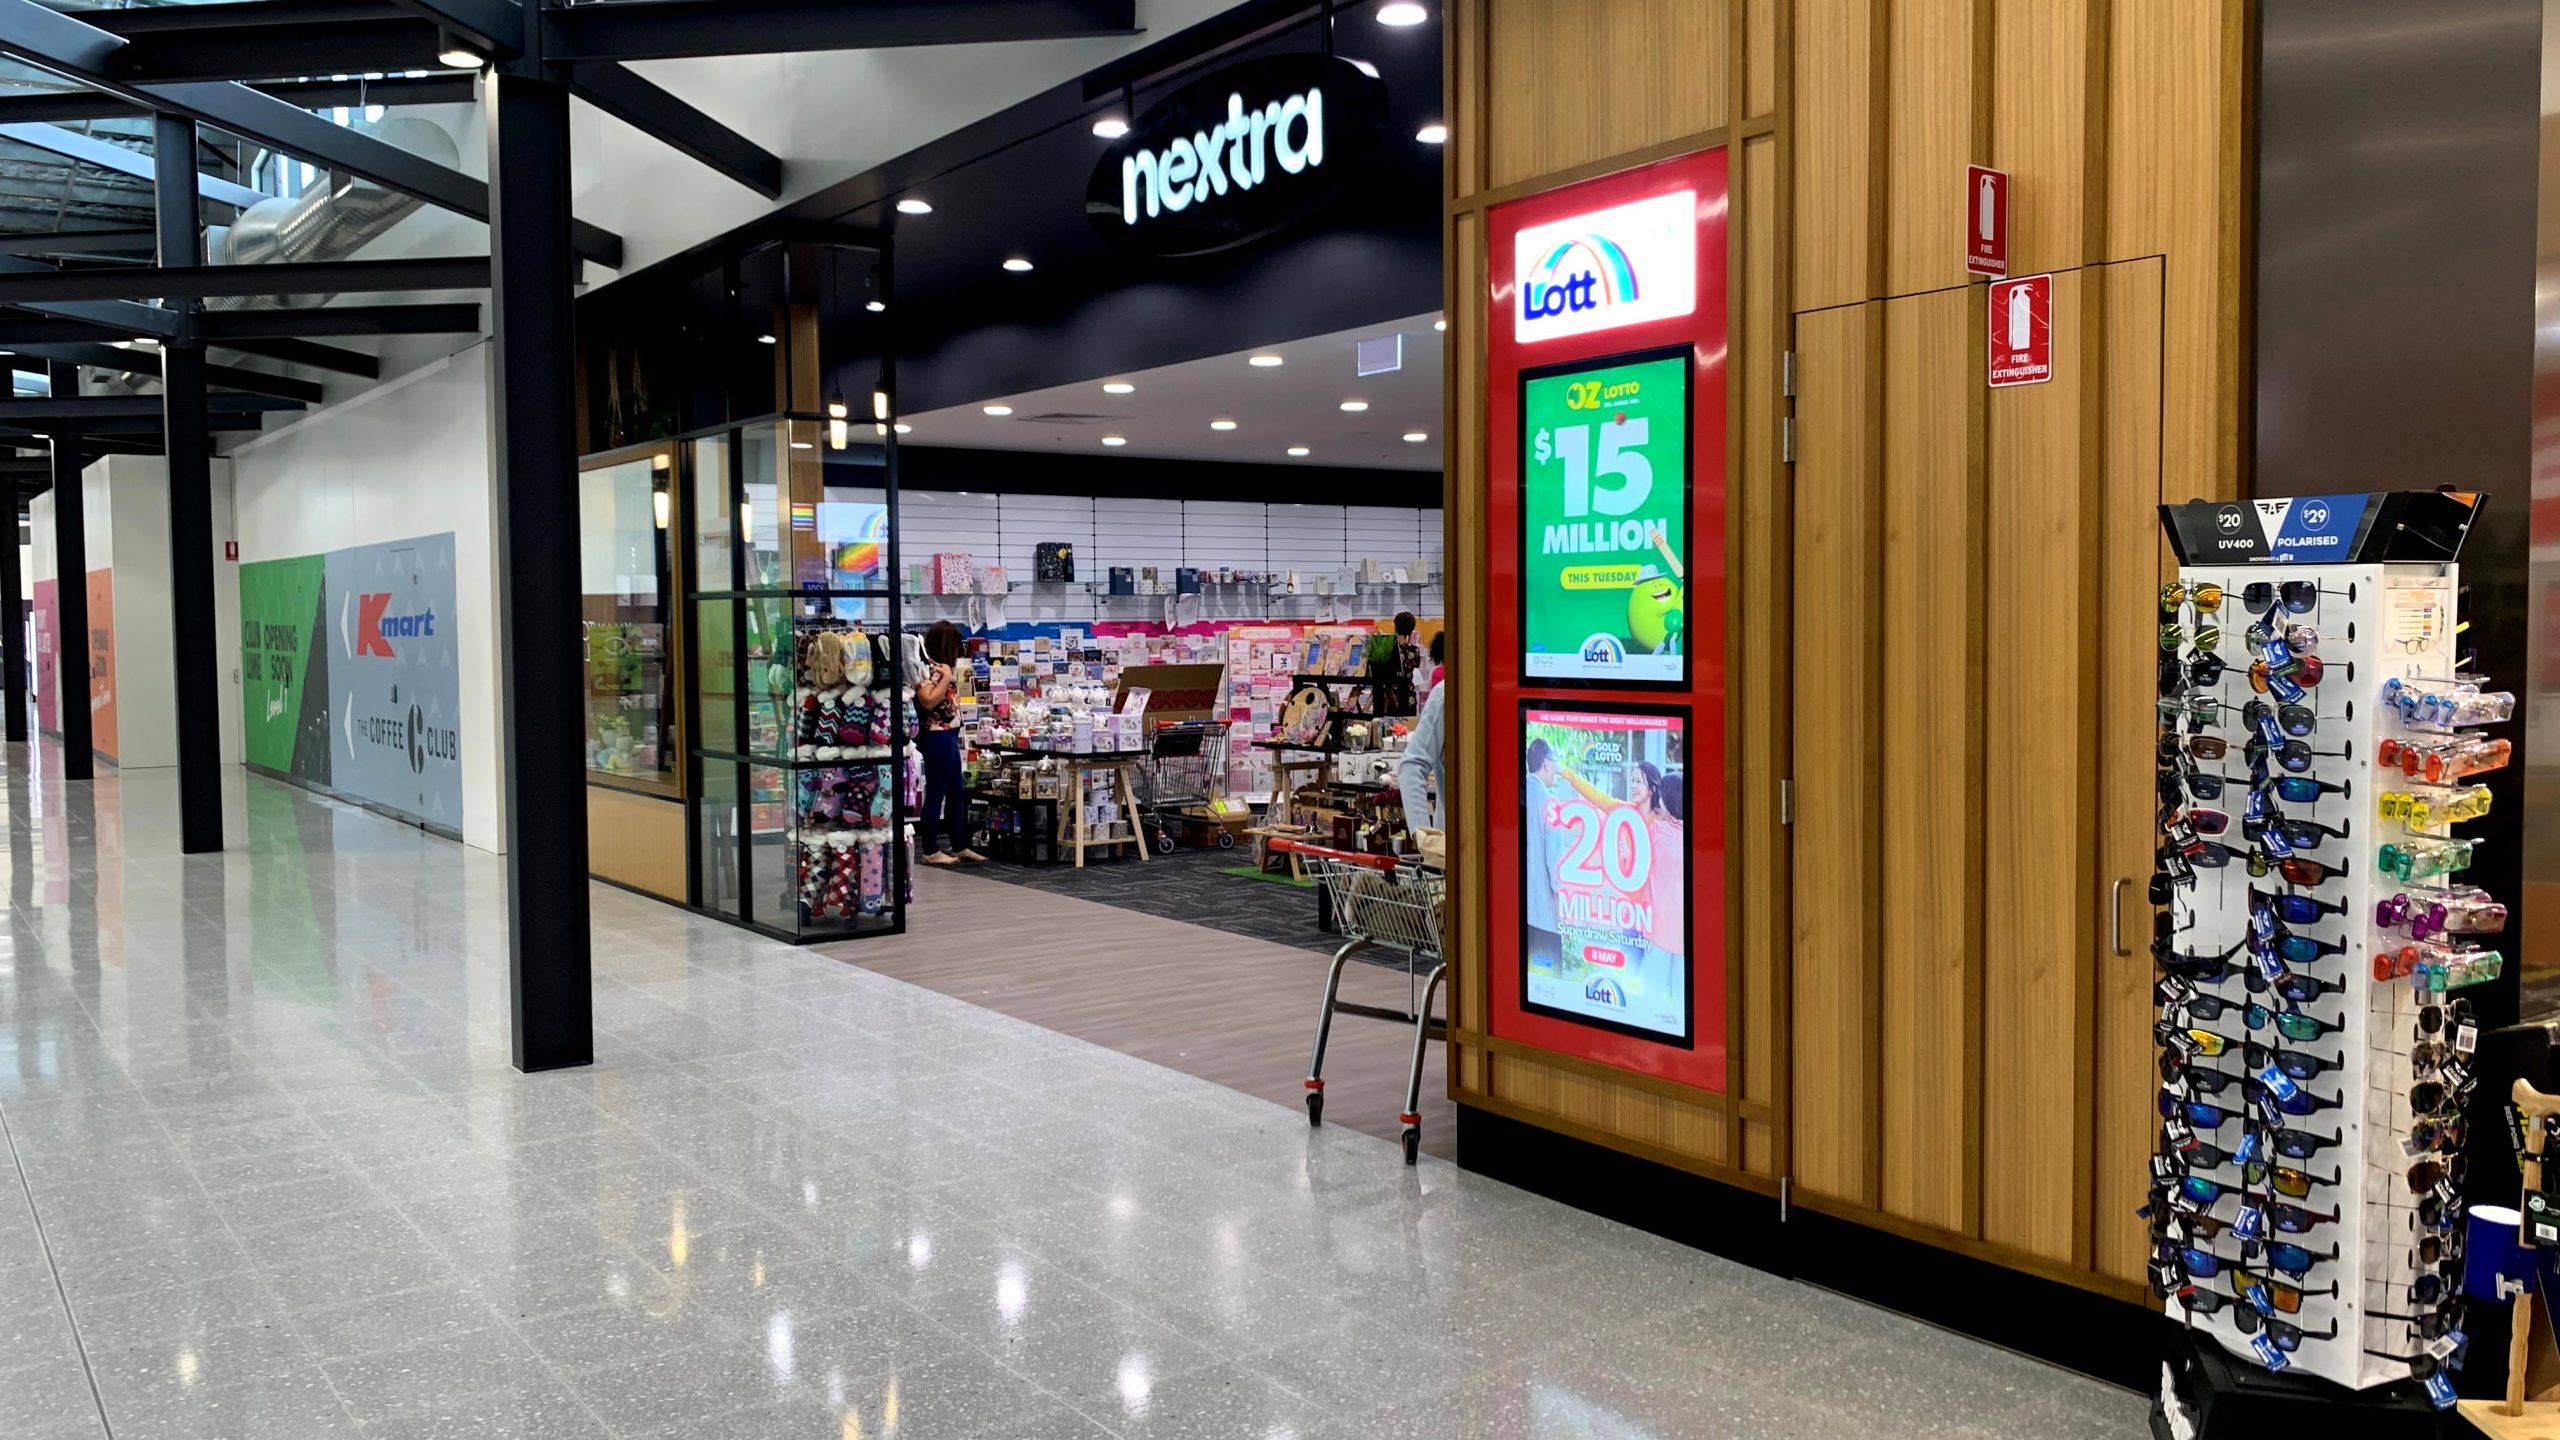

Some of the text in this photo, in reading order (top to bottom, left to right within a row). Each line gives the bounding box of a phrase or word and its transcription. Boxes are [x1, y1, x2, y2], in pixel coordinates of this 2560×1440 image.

[1123, 87, 1322, 225] nextra
[1980, 243, 1993, 254] FIRE
[1968, 255, 2005, 269] EXTINGUISHER
[1524, 269, 1597, 321] Lott
[2011, 353, 2029, 364] FIRE
[1992, 364, 2048, 379] EXTINGUISHER
[1567, 381, 1602, 410] OZ
[1604, 381, 1640, 399] LOTTO
[1534, 416, 1653, 518] $15
[2218, 513, 2241, 528] $20
[2303, 508, 2327, 523] $29
[1542, 518, 1667, 555] MILLION
[2218, 539, 2254, 549] UV400
[2277, 536, 2338, 547] POLARISED
[1568, 571, 1638, 583] THIS TUESDAY
[357, 593, 435, 657] Kmart
[264, 624, 297, 652] OPENING
[1584, 649, 1609, 663] Lott
[271, 655, 293, 682] SOON
[357, 719, 369, 737] THE
[370, 716, 404, 750] COFFEE
[427, 727, 456, 761] CLUB
[1595, 742, 1619, 752] GOLD
[1595, 751, 1622, 762] LOTTO
[1546, 800, 1652, 892] $20
[1558, 891, 1652, 933] MILLION
[1557, 922, 1653, 950] Superdraw Saturday
[1591, 950, 1617, 963] 8 MAY
[1585, 984, 1611, 1004] Lott
